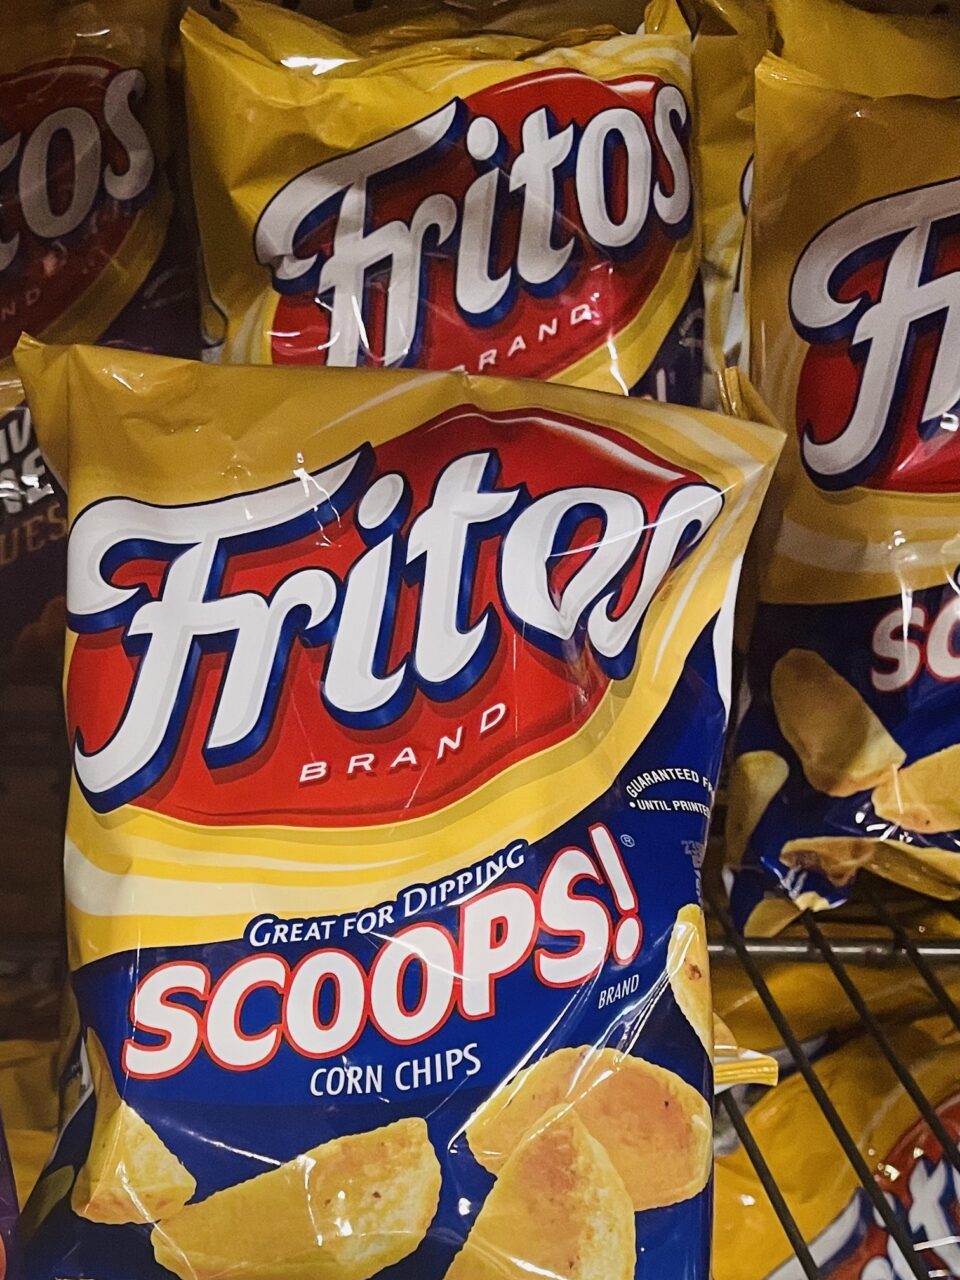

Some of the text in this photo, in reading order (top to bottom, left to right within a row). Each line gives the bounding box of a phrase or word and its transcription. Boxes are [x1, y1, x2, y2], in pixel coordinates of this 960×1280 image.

[257, 84, 688, 366] Fritos
[452, 303, 595, 374] RAND
[299, 703, 506, 783] BRAND
[626, 768, 699, 797] GUARANTEED
[637, 800, 671, 811] UNTIL
[249, 845, 525, 946] GREAT FOR DIPPING
[124, 824, 642, 1080] SCOOPS!
[597, 973, 640, 1009] BRAND
[309, 1043, 482, 1097] CORN CHIPS
